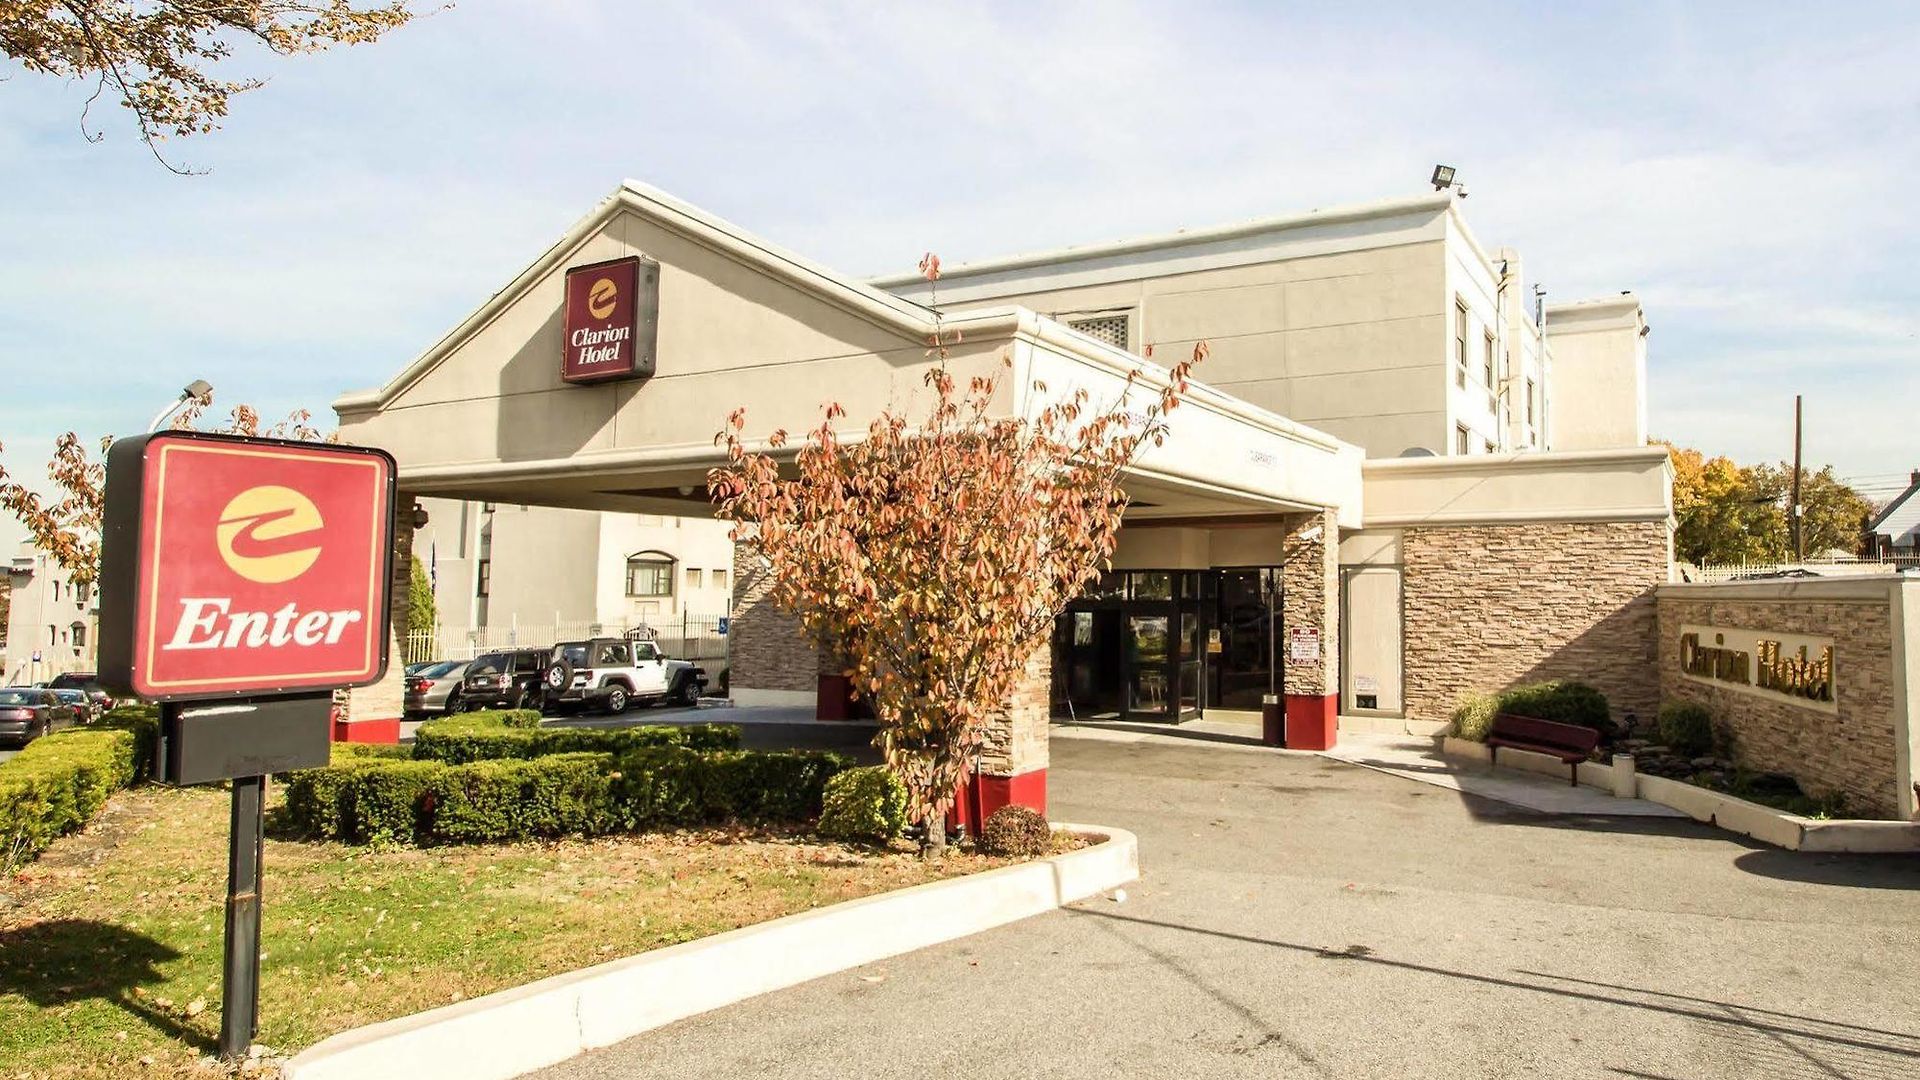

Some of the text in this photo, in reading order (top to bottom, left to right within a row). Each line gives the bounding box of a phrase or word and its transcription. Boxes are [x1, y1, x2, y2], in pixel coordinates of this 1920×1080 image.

[571, 324, 630, 347] Clarion
[577, 342, 621, 365] Hotel
[162, 597, 362, 650] Enter
